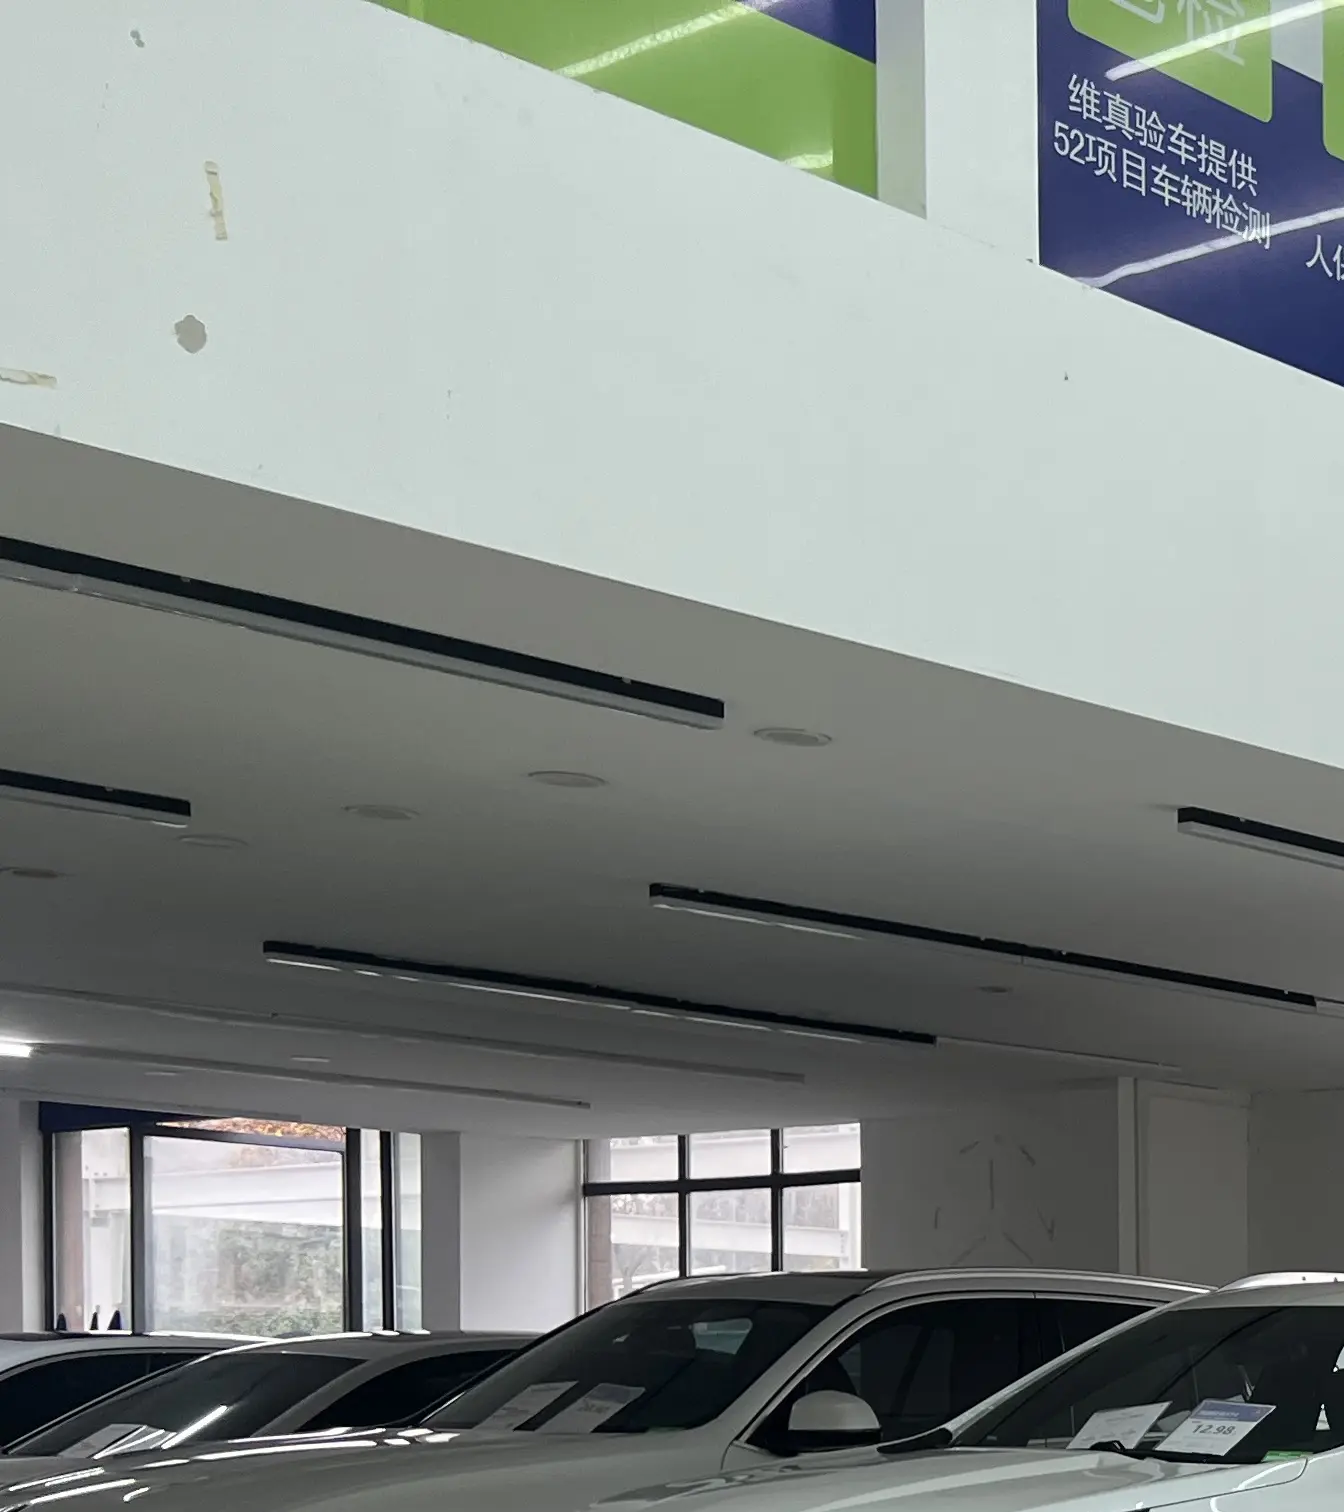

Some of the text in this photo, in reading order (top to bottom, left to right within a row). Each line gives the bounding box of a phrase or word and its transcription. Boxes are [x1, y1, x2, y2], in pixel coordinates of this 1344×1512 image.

[1054, 121, 1271, 249] 52项目车辆检测
[1068, 74, 1257, 196] 维真验车提供
